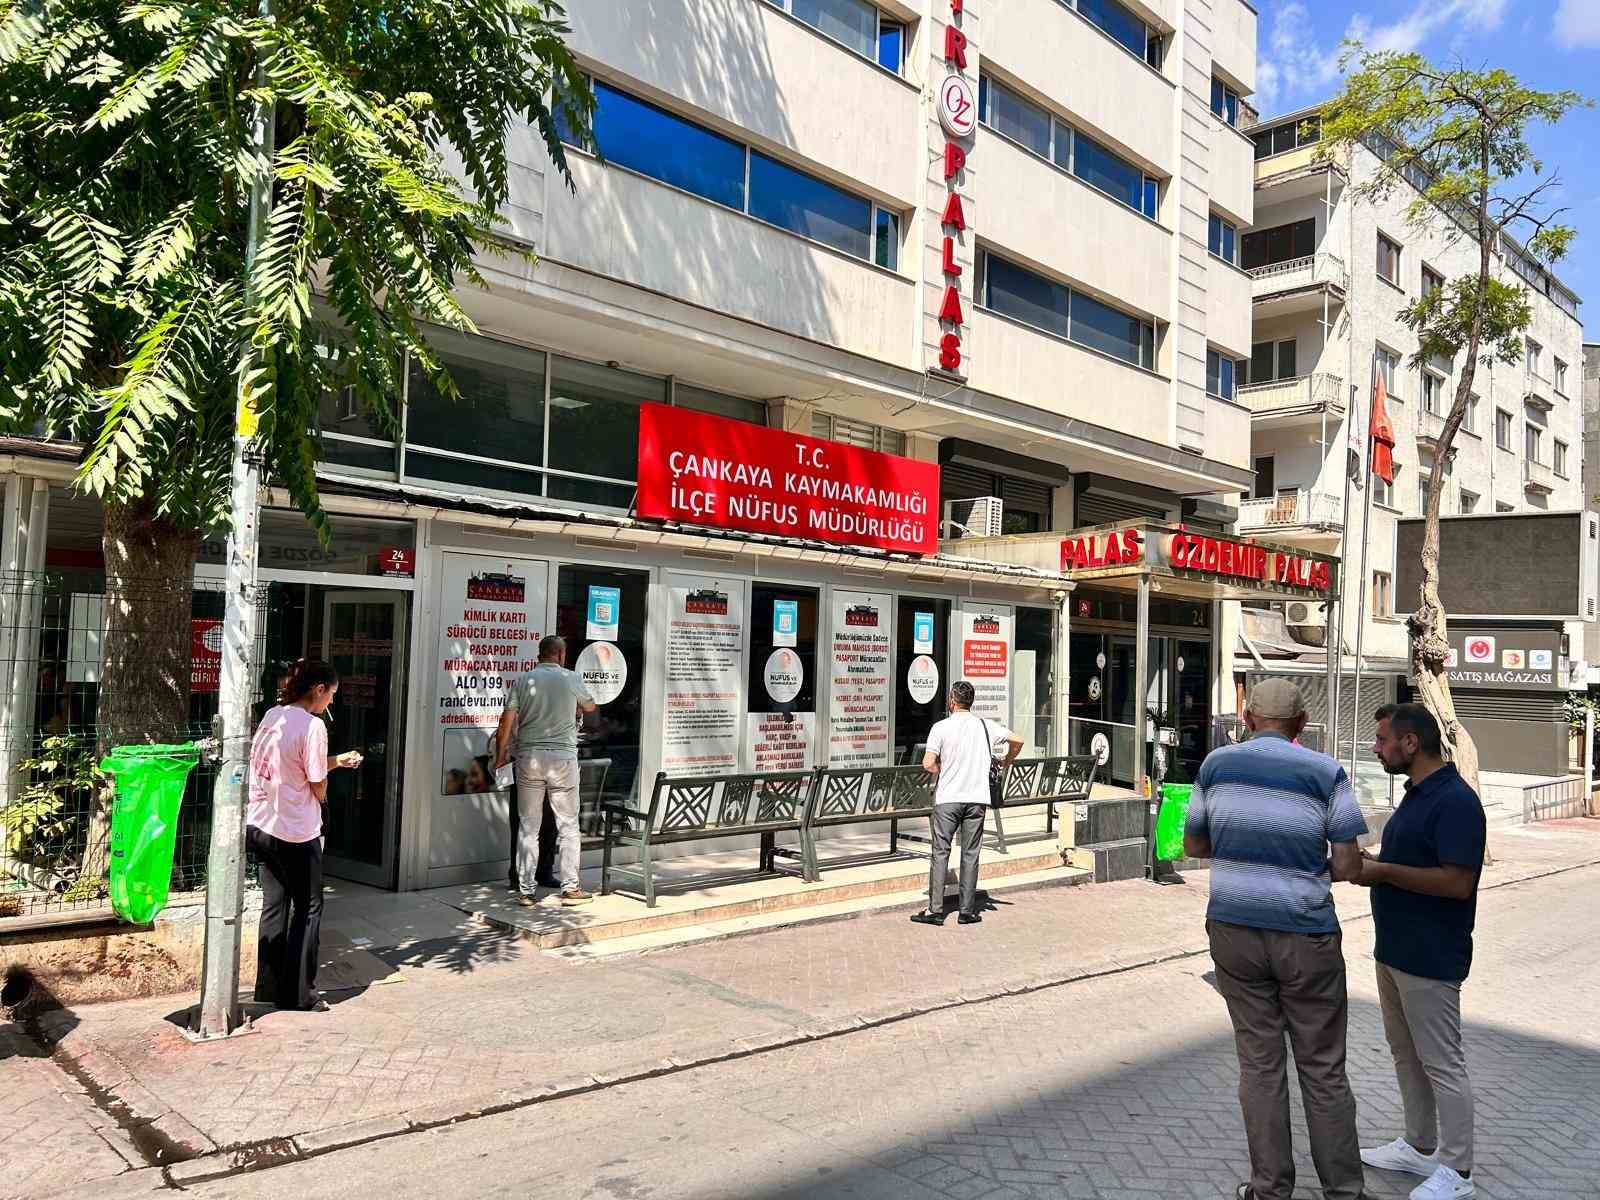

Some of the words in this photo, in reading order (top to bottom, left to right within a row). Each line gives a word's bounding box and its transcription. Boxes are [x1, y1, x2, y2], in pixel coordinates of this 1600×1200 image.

[939, 143, 966, 369] PALAS
[795, 443, 830, 470] T.C.
[668, 451, 773, 489] ÇANKAYA
[785, 472, 927, 515] KAYMAKAMLIĞI
[671, 481, 716, 515] İLÇE
[728, 493, 798, 525] NÜFUS
[808, 507, 924, 543] MÜDÜRLÜĞÜ
[392, 550, 404, 560] 24
[1060, 529, 1140, 572] PALAS
[1169, 523, 1266, 578] ÖZDEMİR
[1275, 552, 1330, 590] PALAS
[464, 608, 497, 621] KİMLİK
[500, 612, 526, 623] KARTI
[447, 624, 487, 638] SÜRÜCÜ
[490, 627, 527, 640] BELGESİ
[530, 632, 540, 640] ve
[470, 644, 517, 656] PASAPORT
[444, 658, 518, 672] MÜRACAATLARI
[456, 676, 477, 688] ALO
[482, 676, 502, 689] 199
[1450, 671, 1482, 683] SATIŞ
[1484, 670, 1552, 683] MAĞAZASI
[440, 694, 507, 707] randevu.nvi
